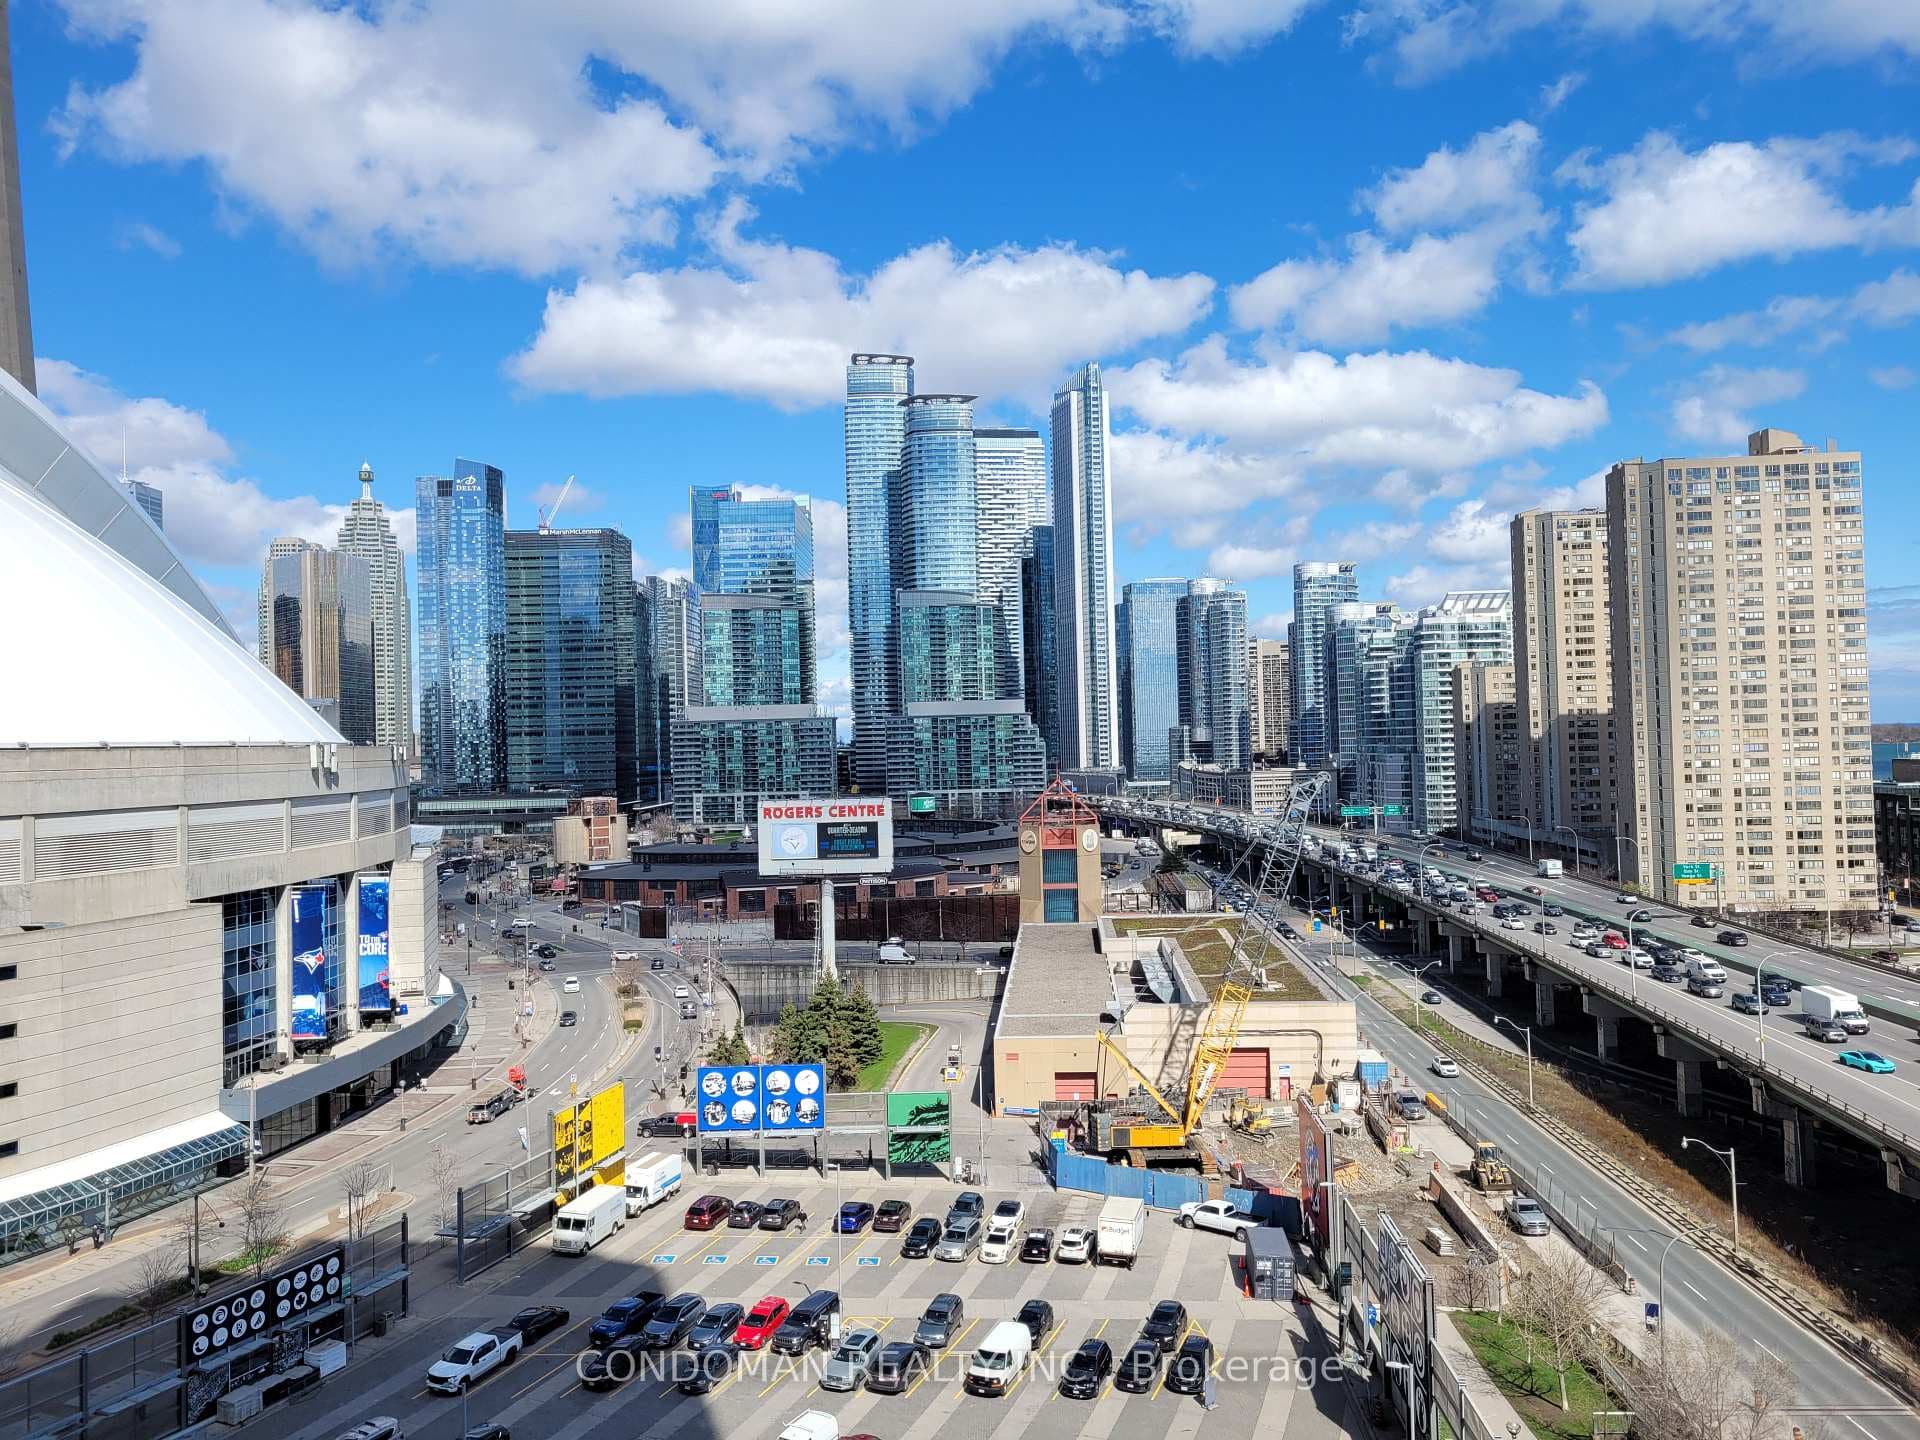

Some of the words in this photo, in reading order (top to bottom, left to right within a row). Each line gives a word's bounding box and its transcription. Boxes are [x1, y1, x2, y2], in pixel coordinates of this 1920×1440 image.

[456, 484, 482, 492] DELTA
[763, 806, 823, 819] ROGERS
[828, 804, 885, 818] CENTRE
[359, 934, 371, 944] TO
[359, 943, 388, 956] CORE
[1108, 1226, 1130, 1235] Budget
